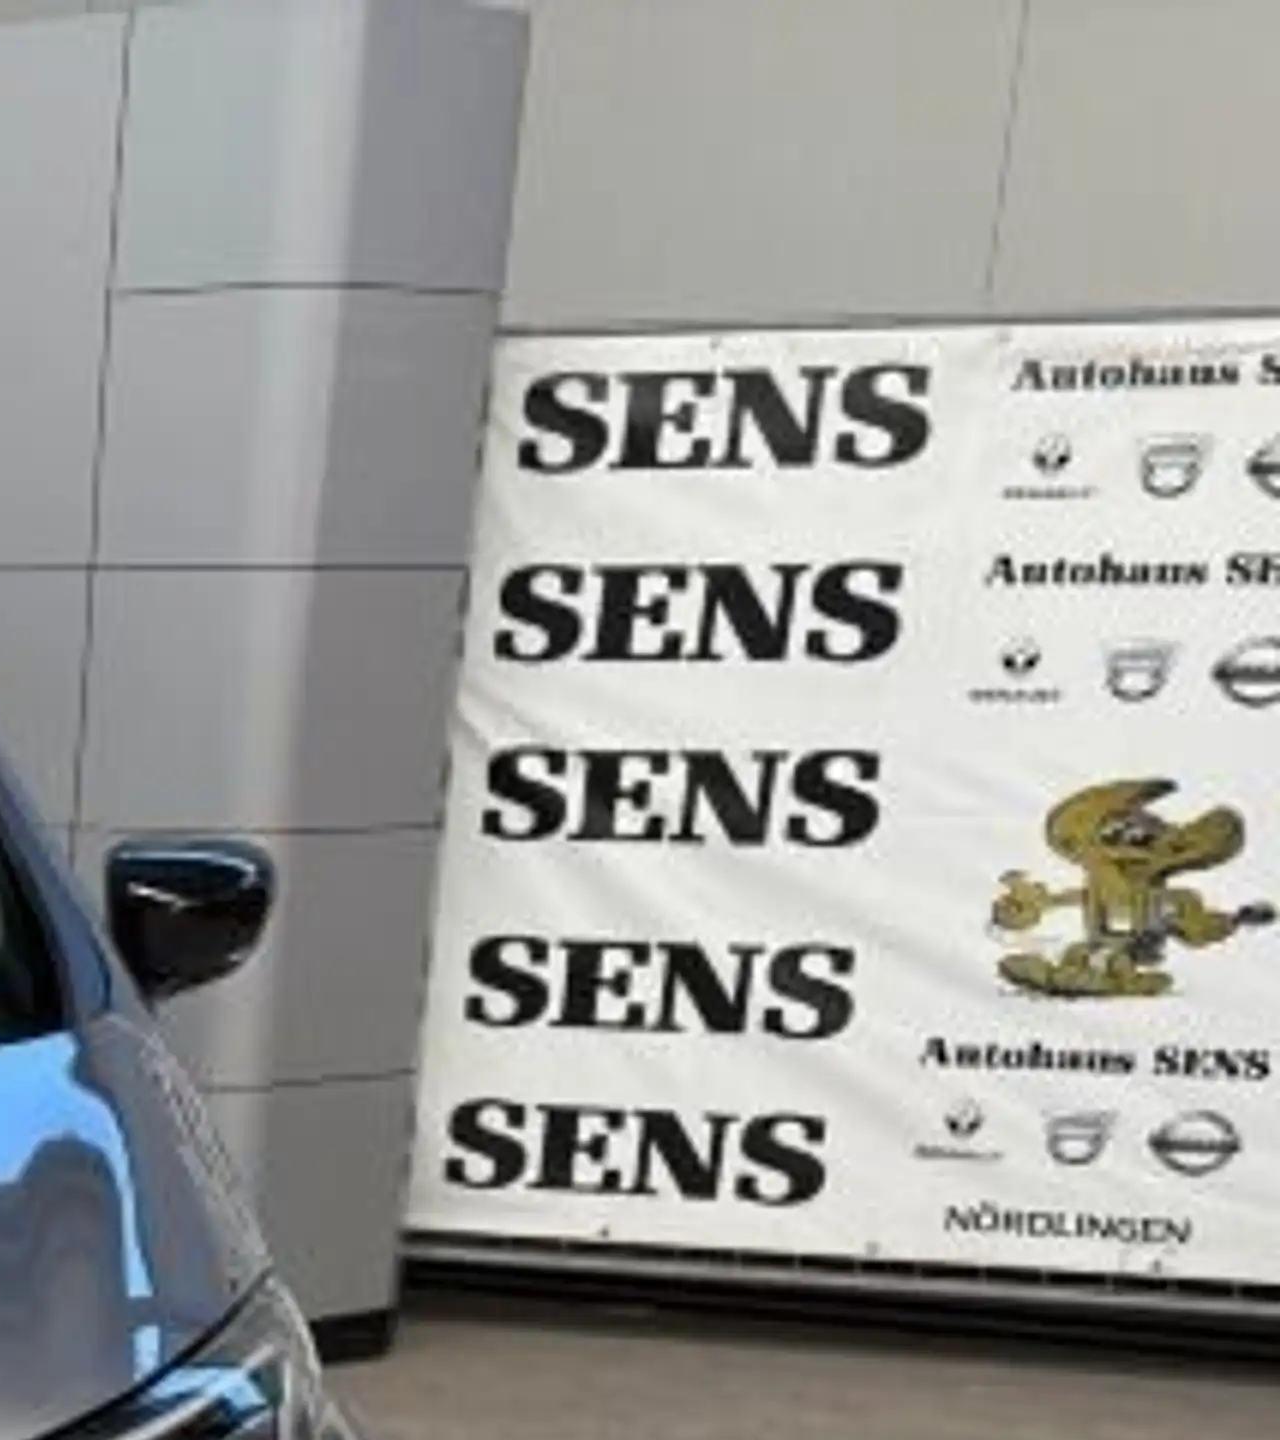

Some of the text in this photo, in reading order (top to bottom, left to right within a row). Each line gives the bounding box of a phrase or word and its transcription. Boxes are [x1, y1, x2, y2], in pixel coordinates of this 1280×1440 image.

[517, 364, 930, 474] SENS
[1010, 357, 1240, 391] Autohaus
[493, 562, 904, 662] SENS
[984, 553, 1209, 586] Autohaus
[480, 747, 881, 848] SENS
[464, 935, 856, 1040] SENS
[917, 1036, 1272, 1081] Autohaus SENS
[444, 1098, 827, 1207] SENS
[943, 1201, 1193, 1245] NÖRDLINGEN
